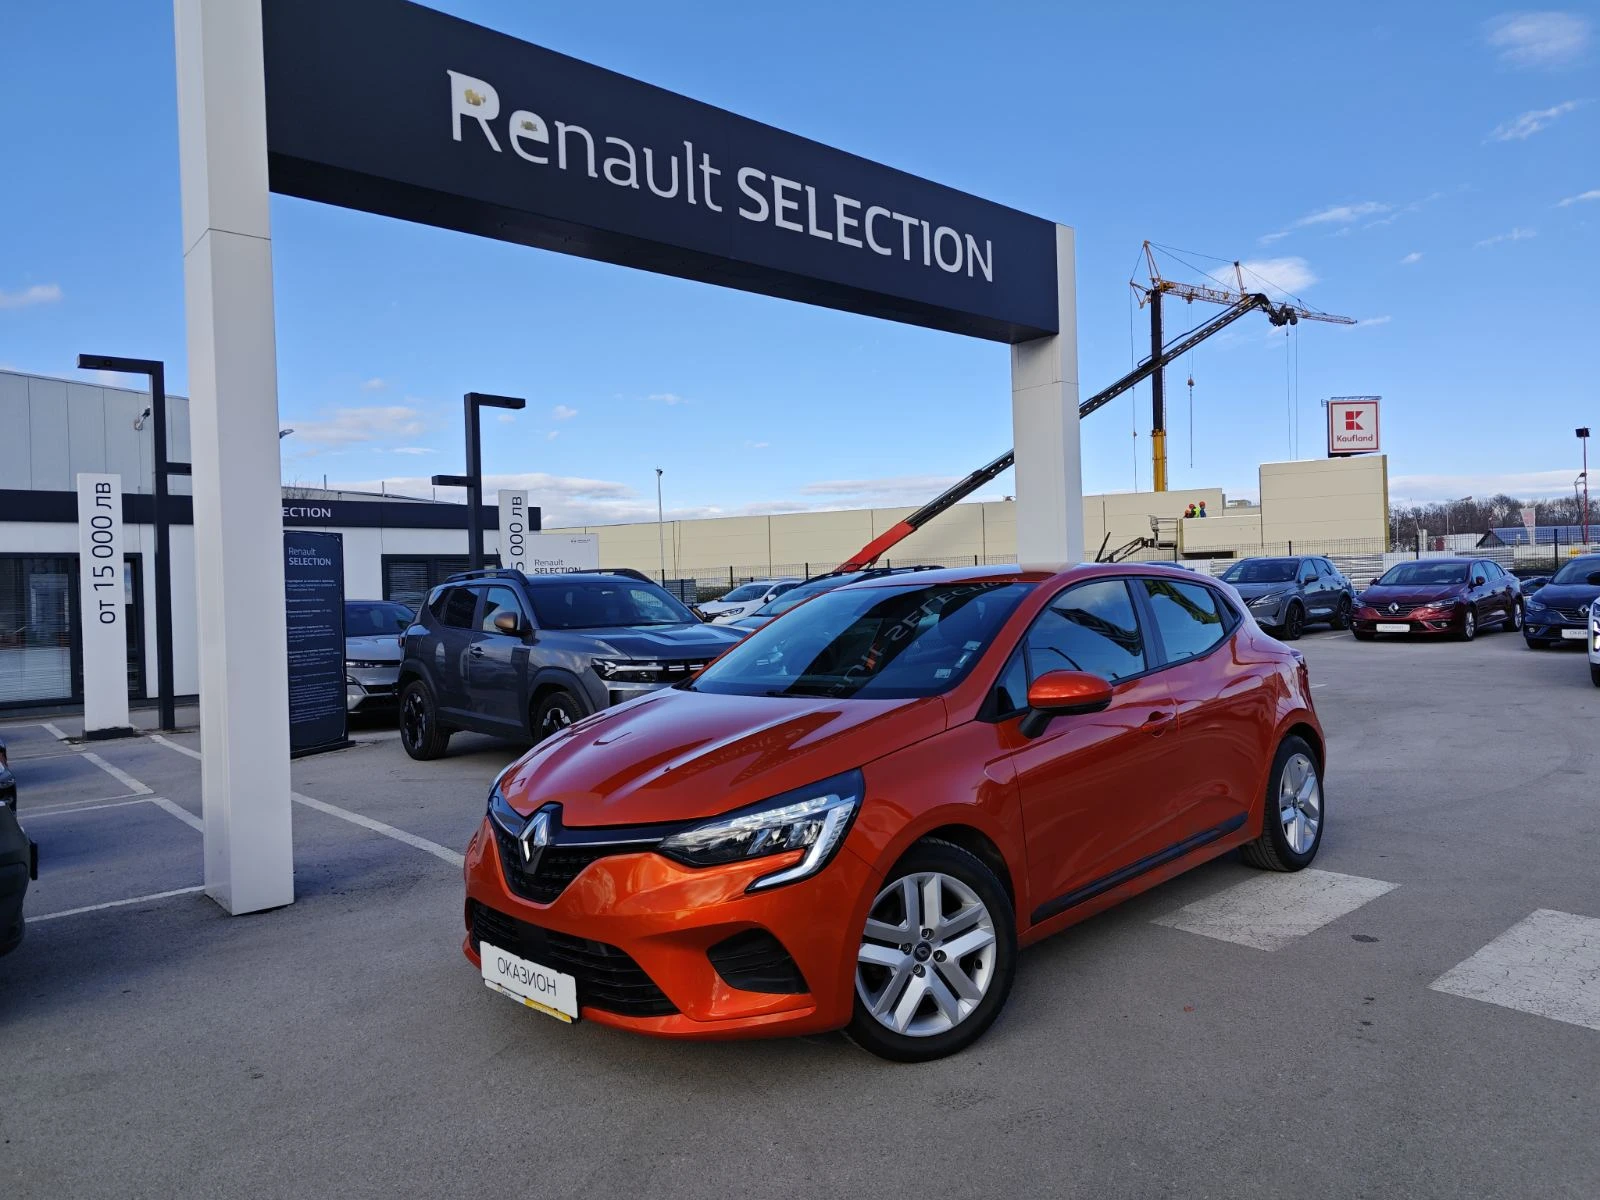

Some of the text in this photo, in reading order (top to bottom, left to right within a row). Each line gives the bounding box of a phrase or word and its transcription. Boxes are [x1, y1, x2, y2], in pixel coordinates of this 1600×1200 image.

[446, 69, 994, 283] Renault SELECTION
[1336, 434, 1373, 442] Kaufland
[90, 515, 114, 559] 000
[509, 522, 524, 556] 000
[288, 547, 316, 556] Renault
[288, 557, 332, 566] SELECTION
[534, 559, 564, 567] Renault
[92, 566, 115, 592] 15
[497, 957, 557, 997] ОКАЗИОН
